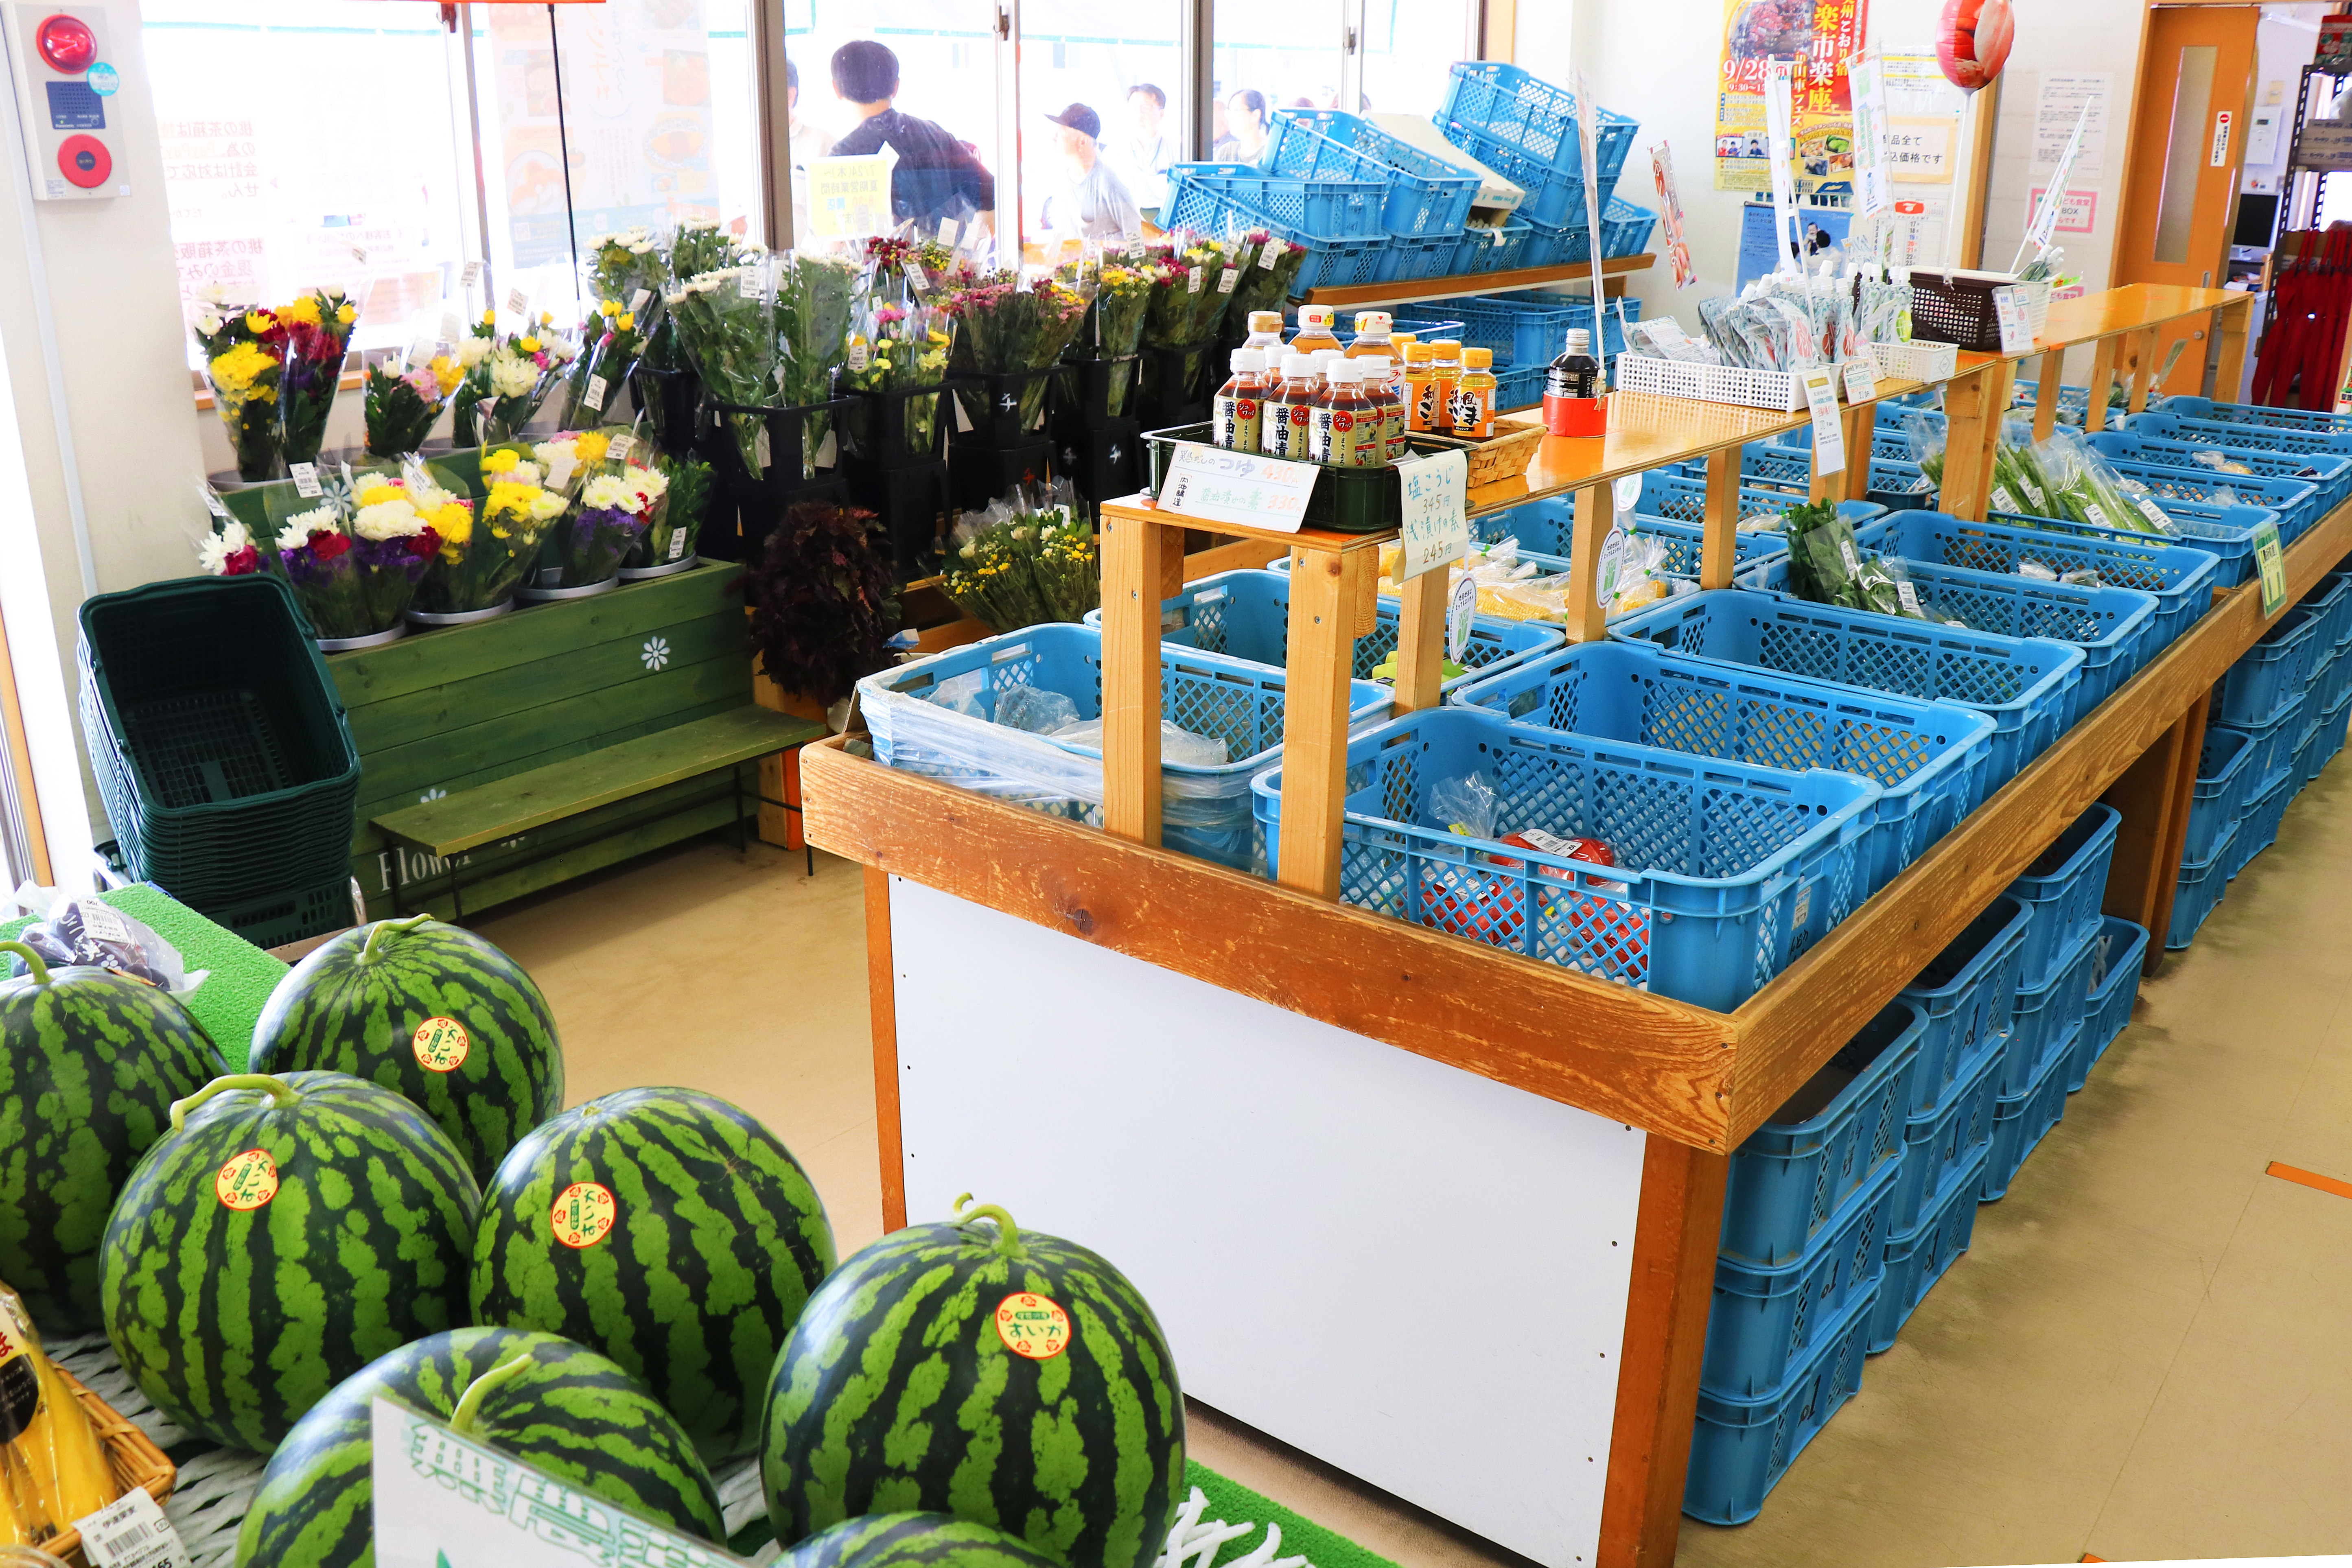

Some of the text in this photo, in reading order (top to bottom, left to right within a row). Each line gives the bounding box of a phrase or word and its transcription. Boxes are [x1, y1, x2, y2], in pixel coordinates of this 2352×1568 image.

[1836, 0, 1854, 77] 州こおり宿
[1807, 4, 1839, 113] 楽市楽座
[1884, 151, 1943, 164] 込価格です
[1335, 414, 1346, 423] ジュ
[1339, 421, 1352, 429] ワッ!
[1453, 405, 1481, 426] ごま
[1219, 459, 1255, 477] つゆ
[1408, 465, 1454, 501] 塩こうじ
[1268, 494, 1302, 512] 330円
[1423, 494, 1451, 514] 345円
[1406, 508, 1460, 543] 浅漬けの素
[1423, 541, 1452, 564] 245円
[434, 1026, 458, 1065] すいか
[241, 1158, 269, 1202] すいか
[581, 1189, 596, 1237] すいか
[1009, 1323, 1062, 1340] すいか
